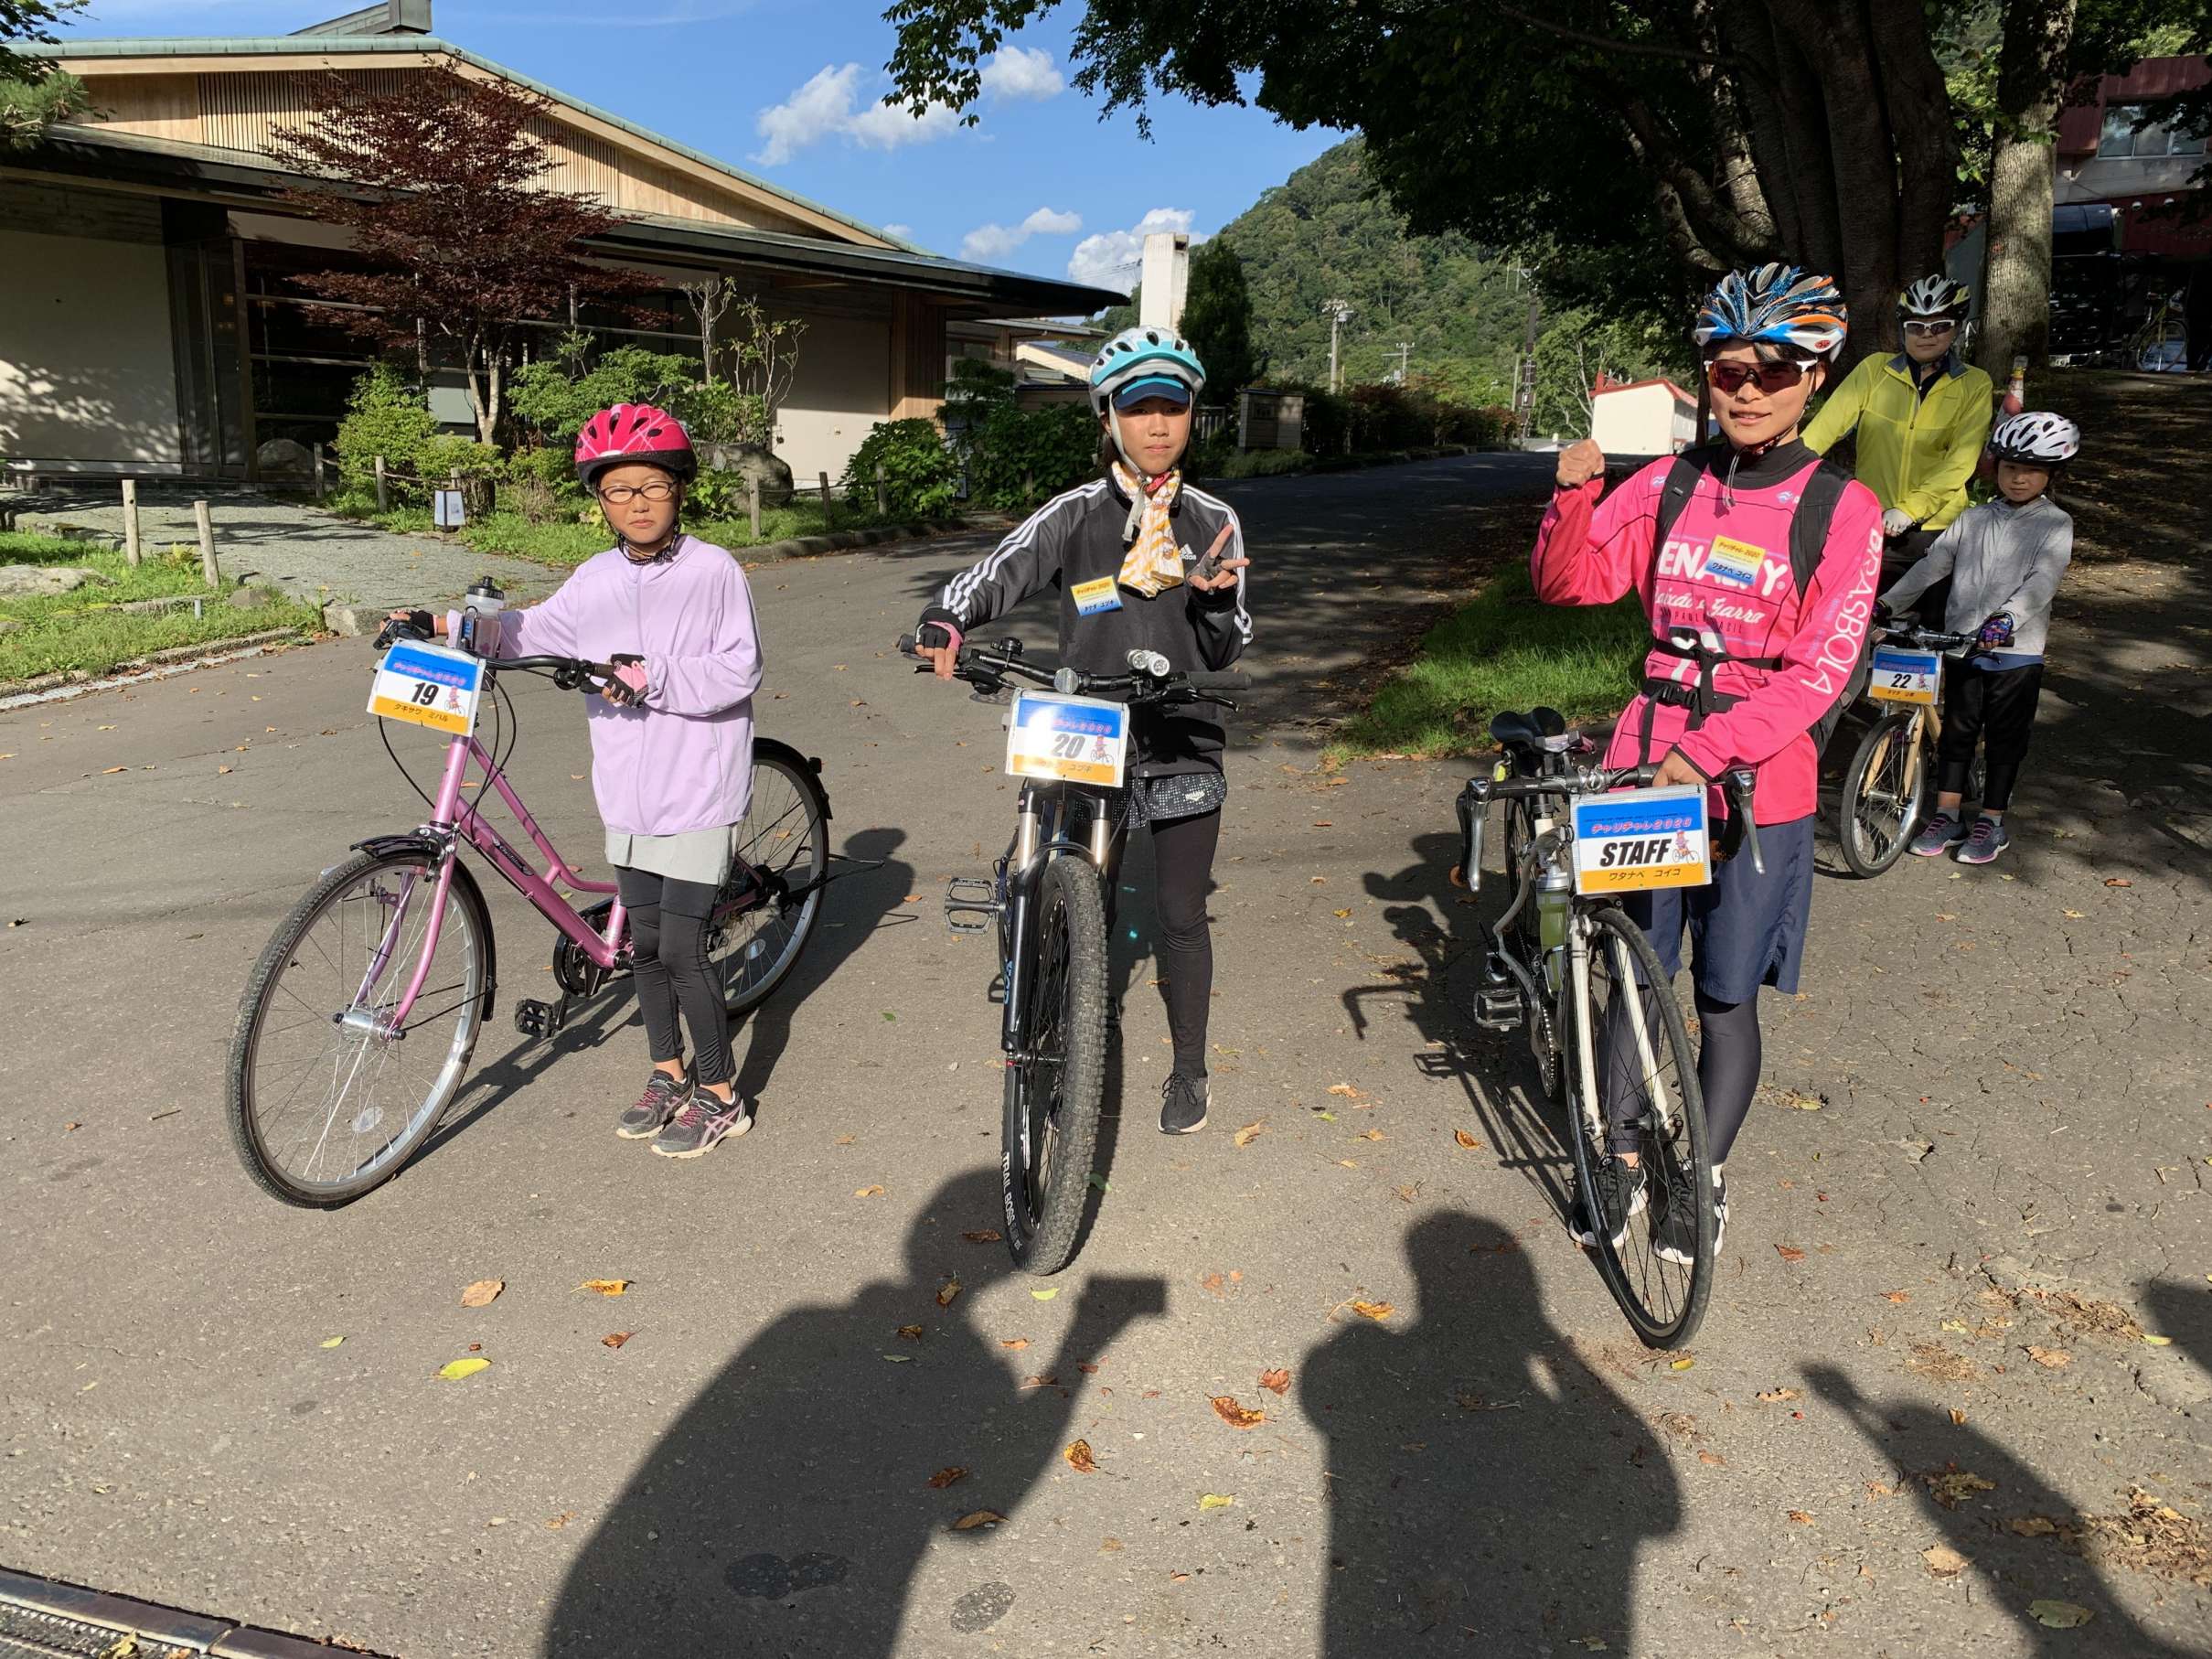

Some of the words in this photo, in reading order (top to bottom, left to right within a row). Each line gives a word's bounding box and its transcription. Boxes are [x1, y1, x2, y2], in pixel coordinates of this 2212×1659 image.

[1801, 527, 1882, 695] BRASBOLA
[411, 681, 440, 706] 19
[1891, 673, 1912, 689] 22
[1053, 733, 1085, 758] 20
[1600, 839, 1672, 867] STAFF
[1608, 870, 1646, 882] ワタナベ
[1002, 1151, 1011, 1194] TRAIL
[1004, 1192, 1016, 1226] BOSS
